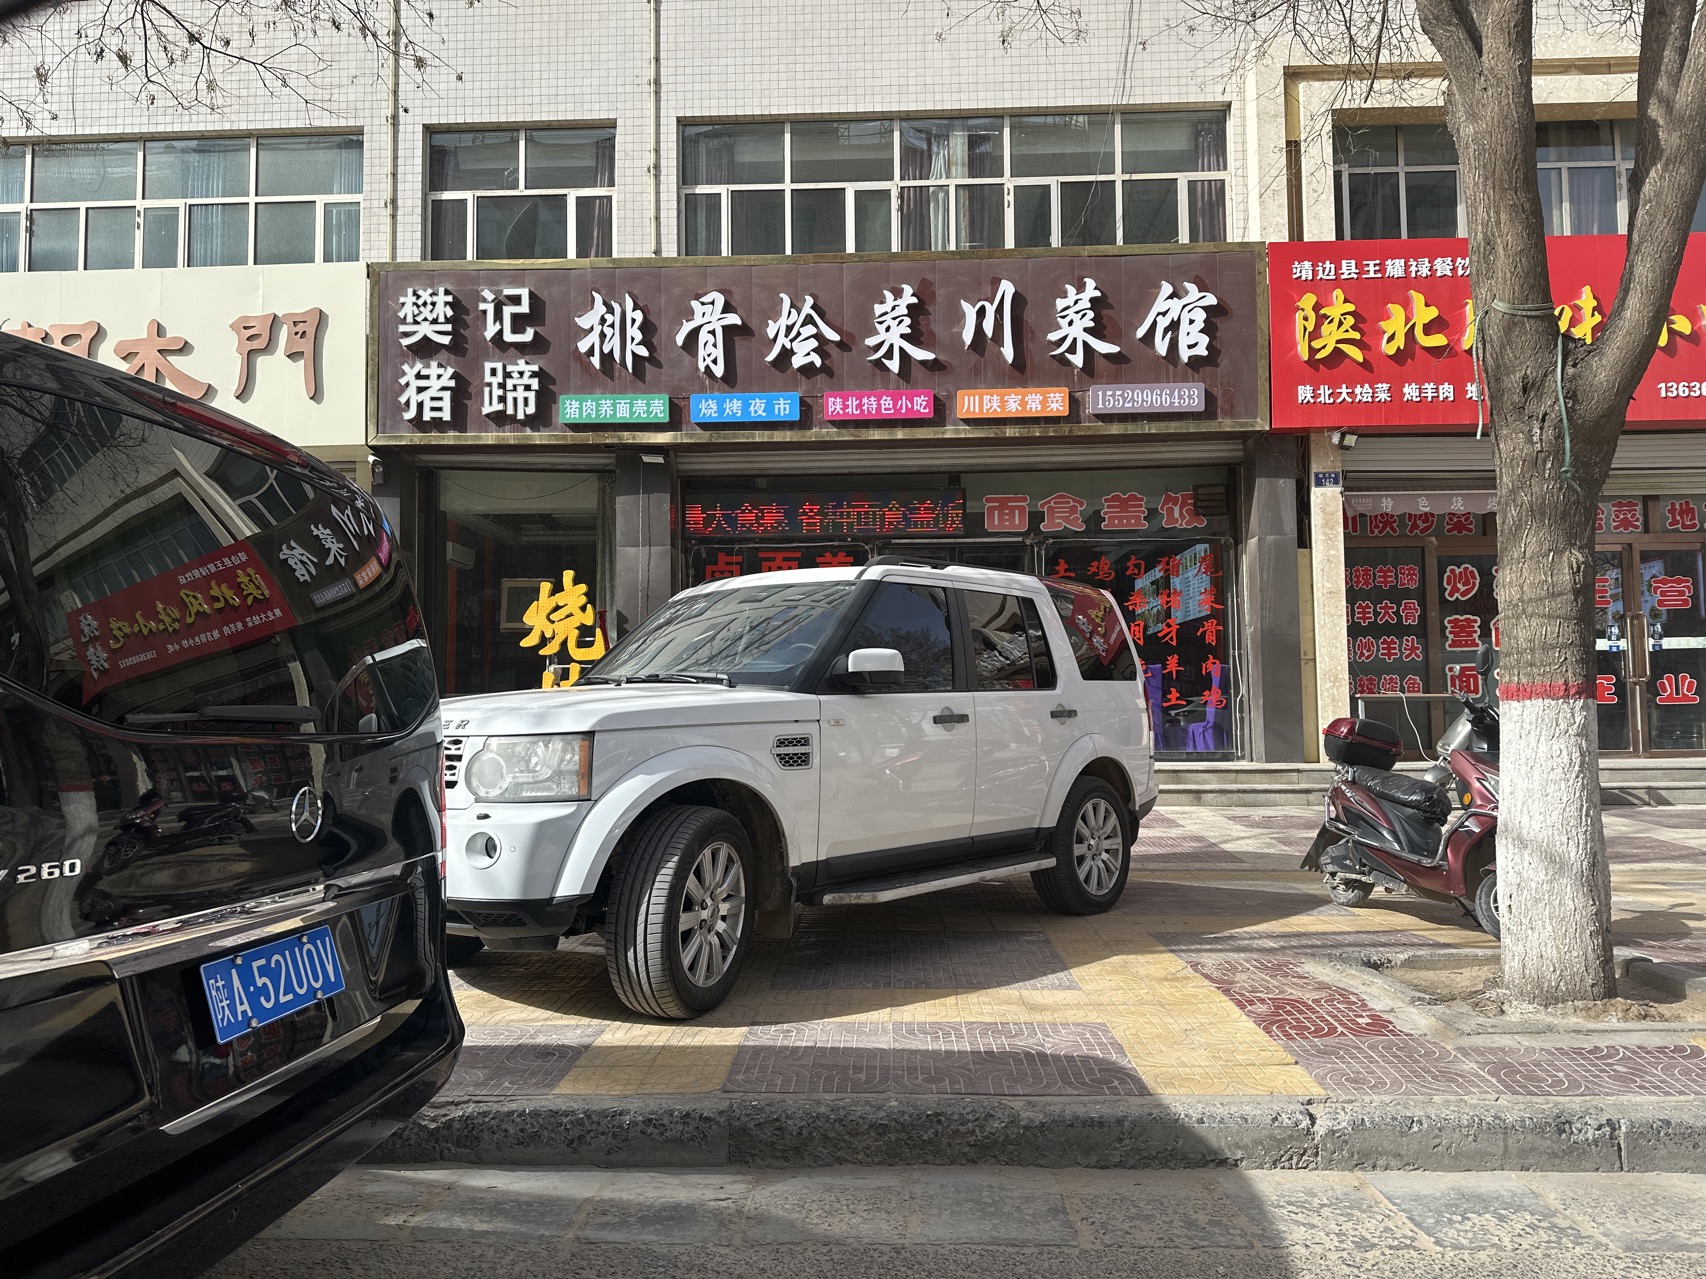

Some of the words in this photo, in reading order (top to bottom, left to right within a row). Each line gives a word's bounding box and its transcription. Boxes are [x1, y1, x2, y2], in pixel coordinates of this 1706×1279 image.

[1292, 257, 1470, 281] 靖边县王耀禄餐饮
[398, 287, 531, 346] 樊记
[574, 278, 1218, 378] 排骨烩菜川菜馆
[1294, 285, 1706, 363] 陕北味
[398, 361, 540, 421] 猪蹄
[962, 391, 1064, 413] 川陕家常菜
[1096, 388, 1198, 408] 15529966433
[1297, 383, 1391, 404] 陕北大烩菜
[1403, 382, 1455, 402] 炖羊肉
[565, 399, 664, 418] 猪肉荞面壳壳
[699, 398, 791, 417] 烧烤夜市
[828, 395, 929, 415] 陕北特色小吃
[1321, 478, 1334, 486] 142
[983, 492, 1207, 531] 面食盖饭
[1666, 499, 1706, 531] 地
[1107, 587, 1224, 614] 杀猪菜
[16, 859, 81, 884] 260
